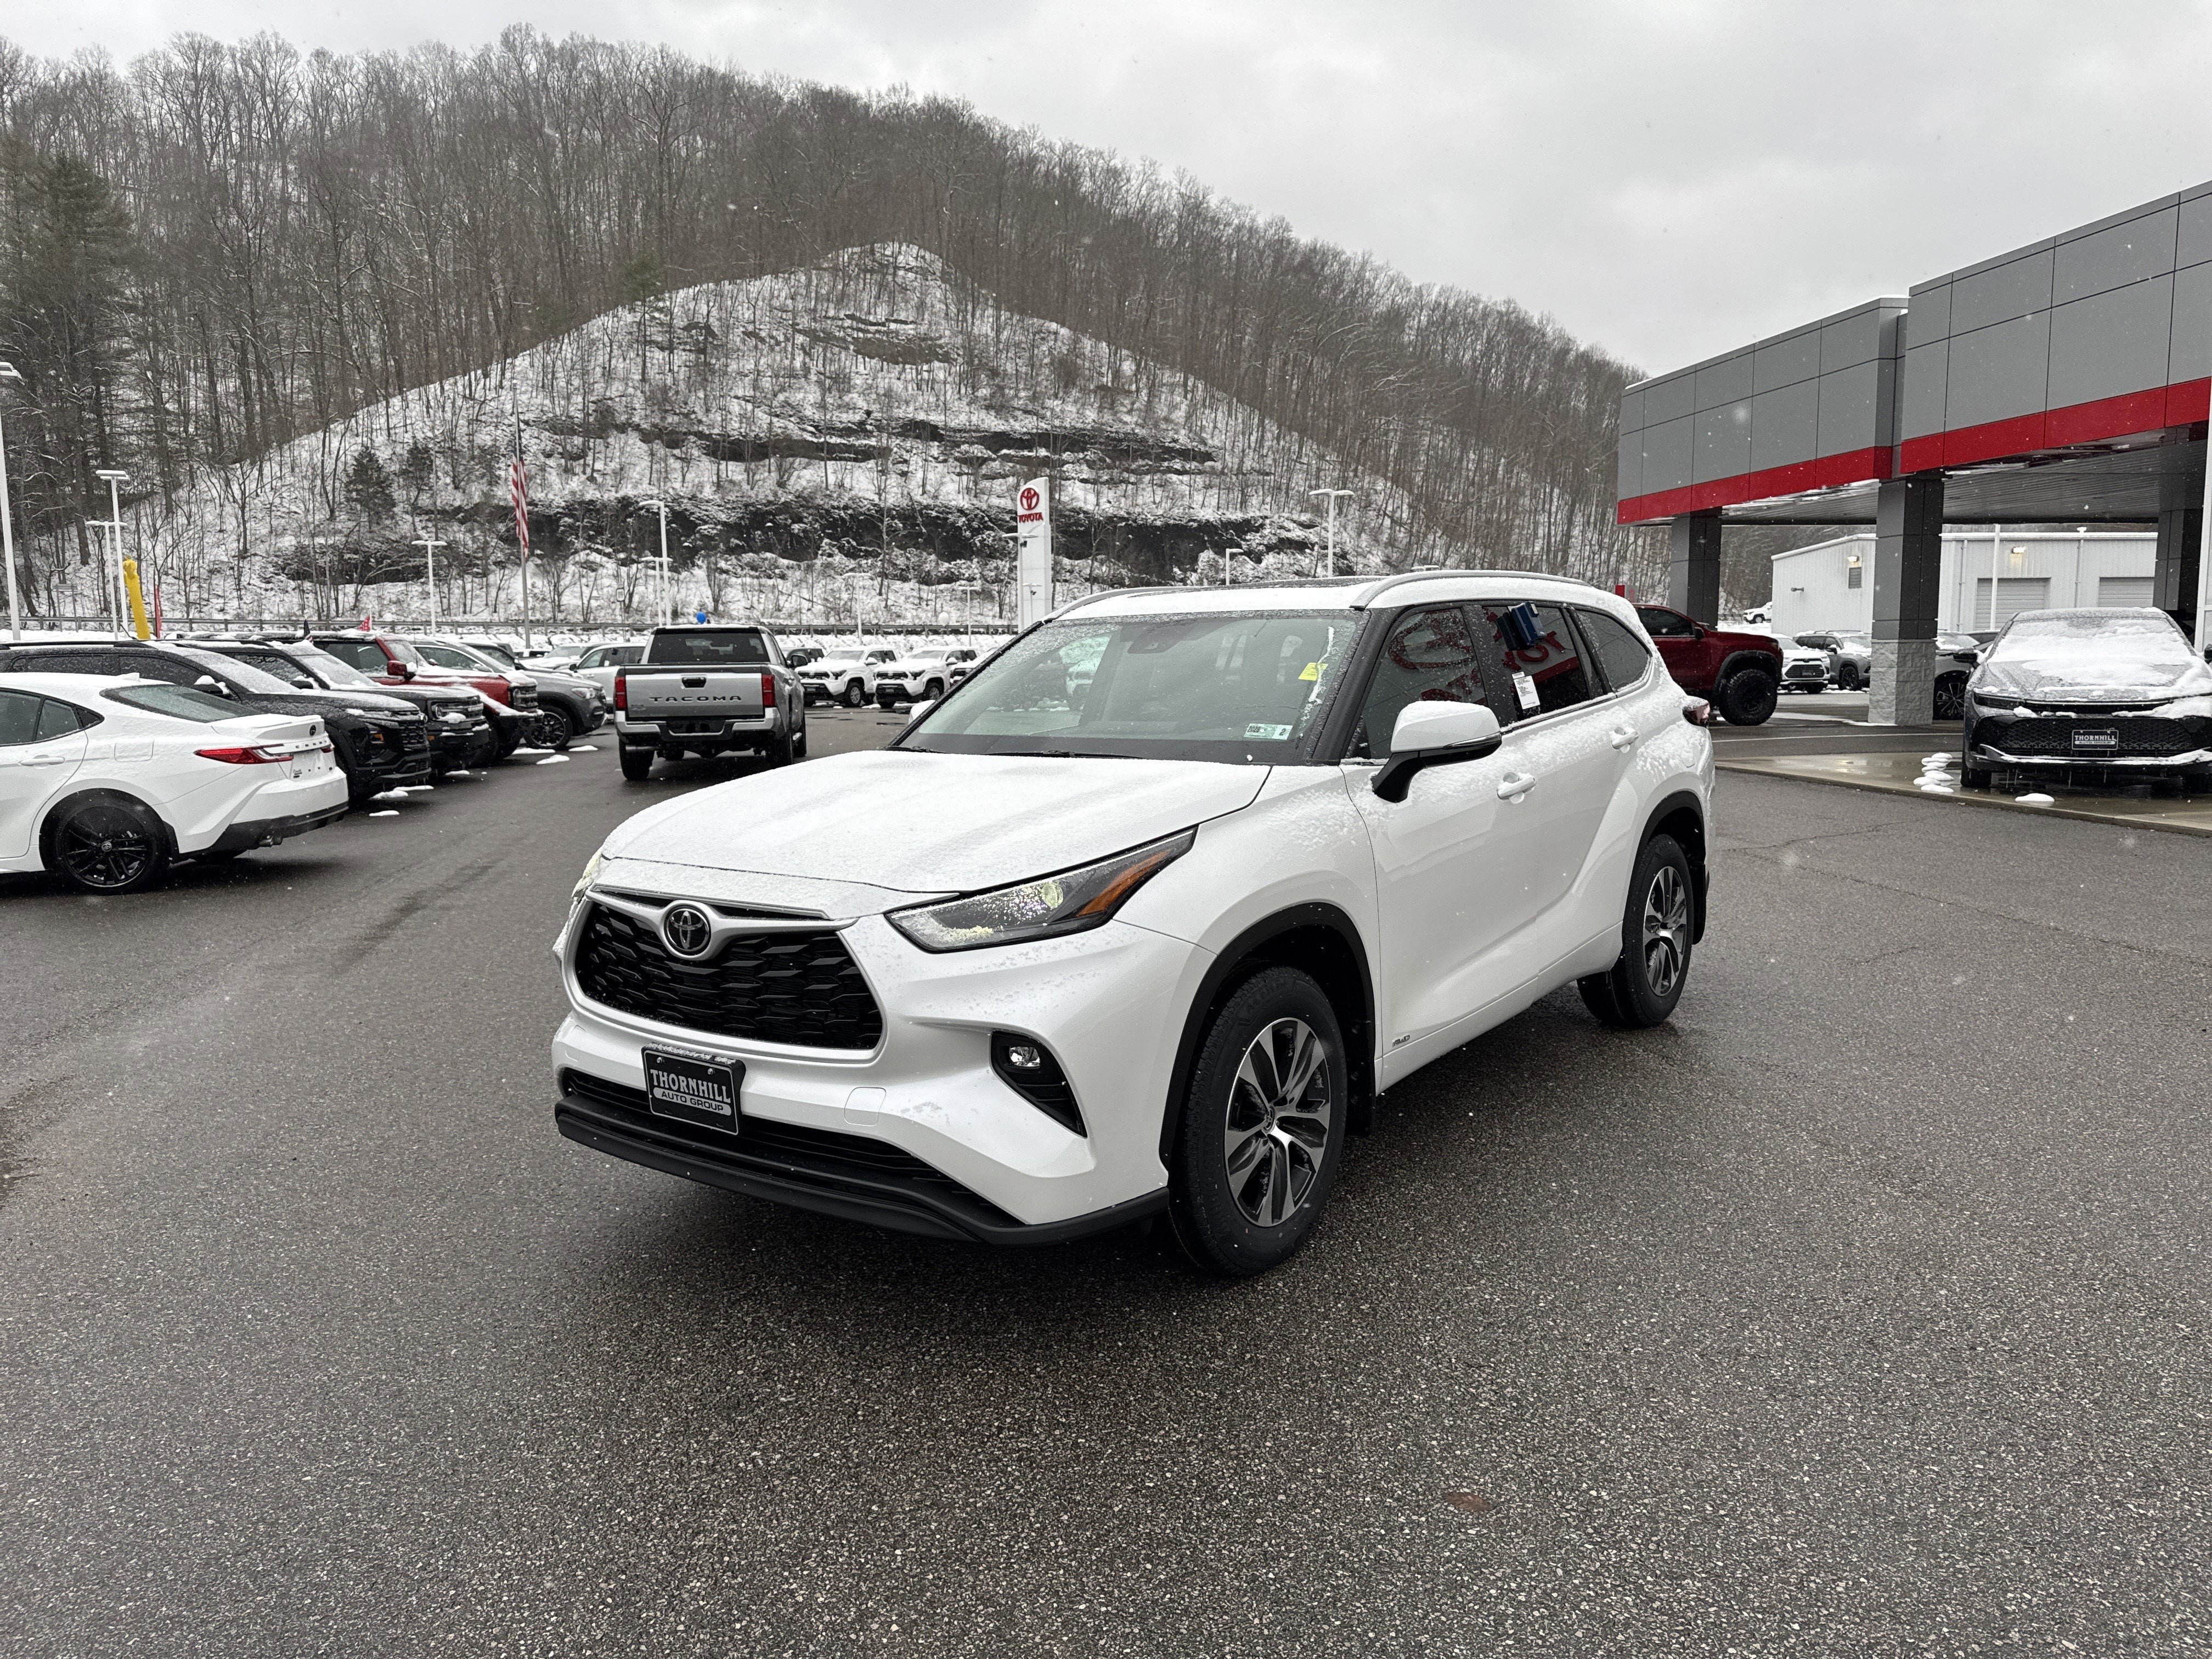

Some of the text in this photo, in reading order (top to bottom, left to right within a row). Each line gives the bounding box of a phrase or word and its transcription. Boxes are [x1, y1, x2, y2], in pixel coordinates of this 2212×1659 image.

[1018, 512, 1043, 523] TOYOTA
[650, 1069, 731, 1103] THORNHILL
[661, 1090, 724, 1112] AUTO GROUP
